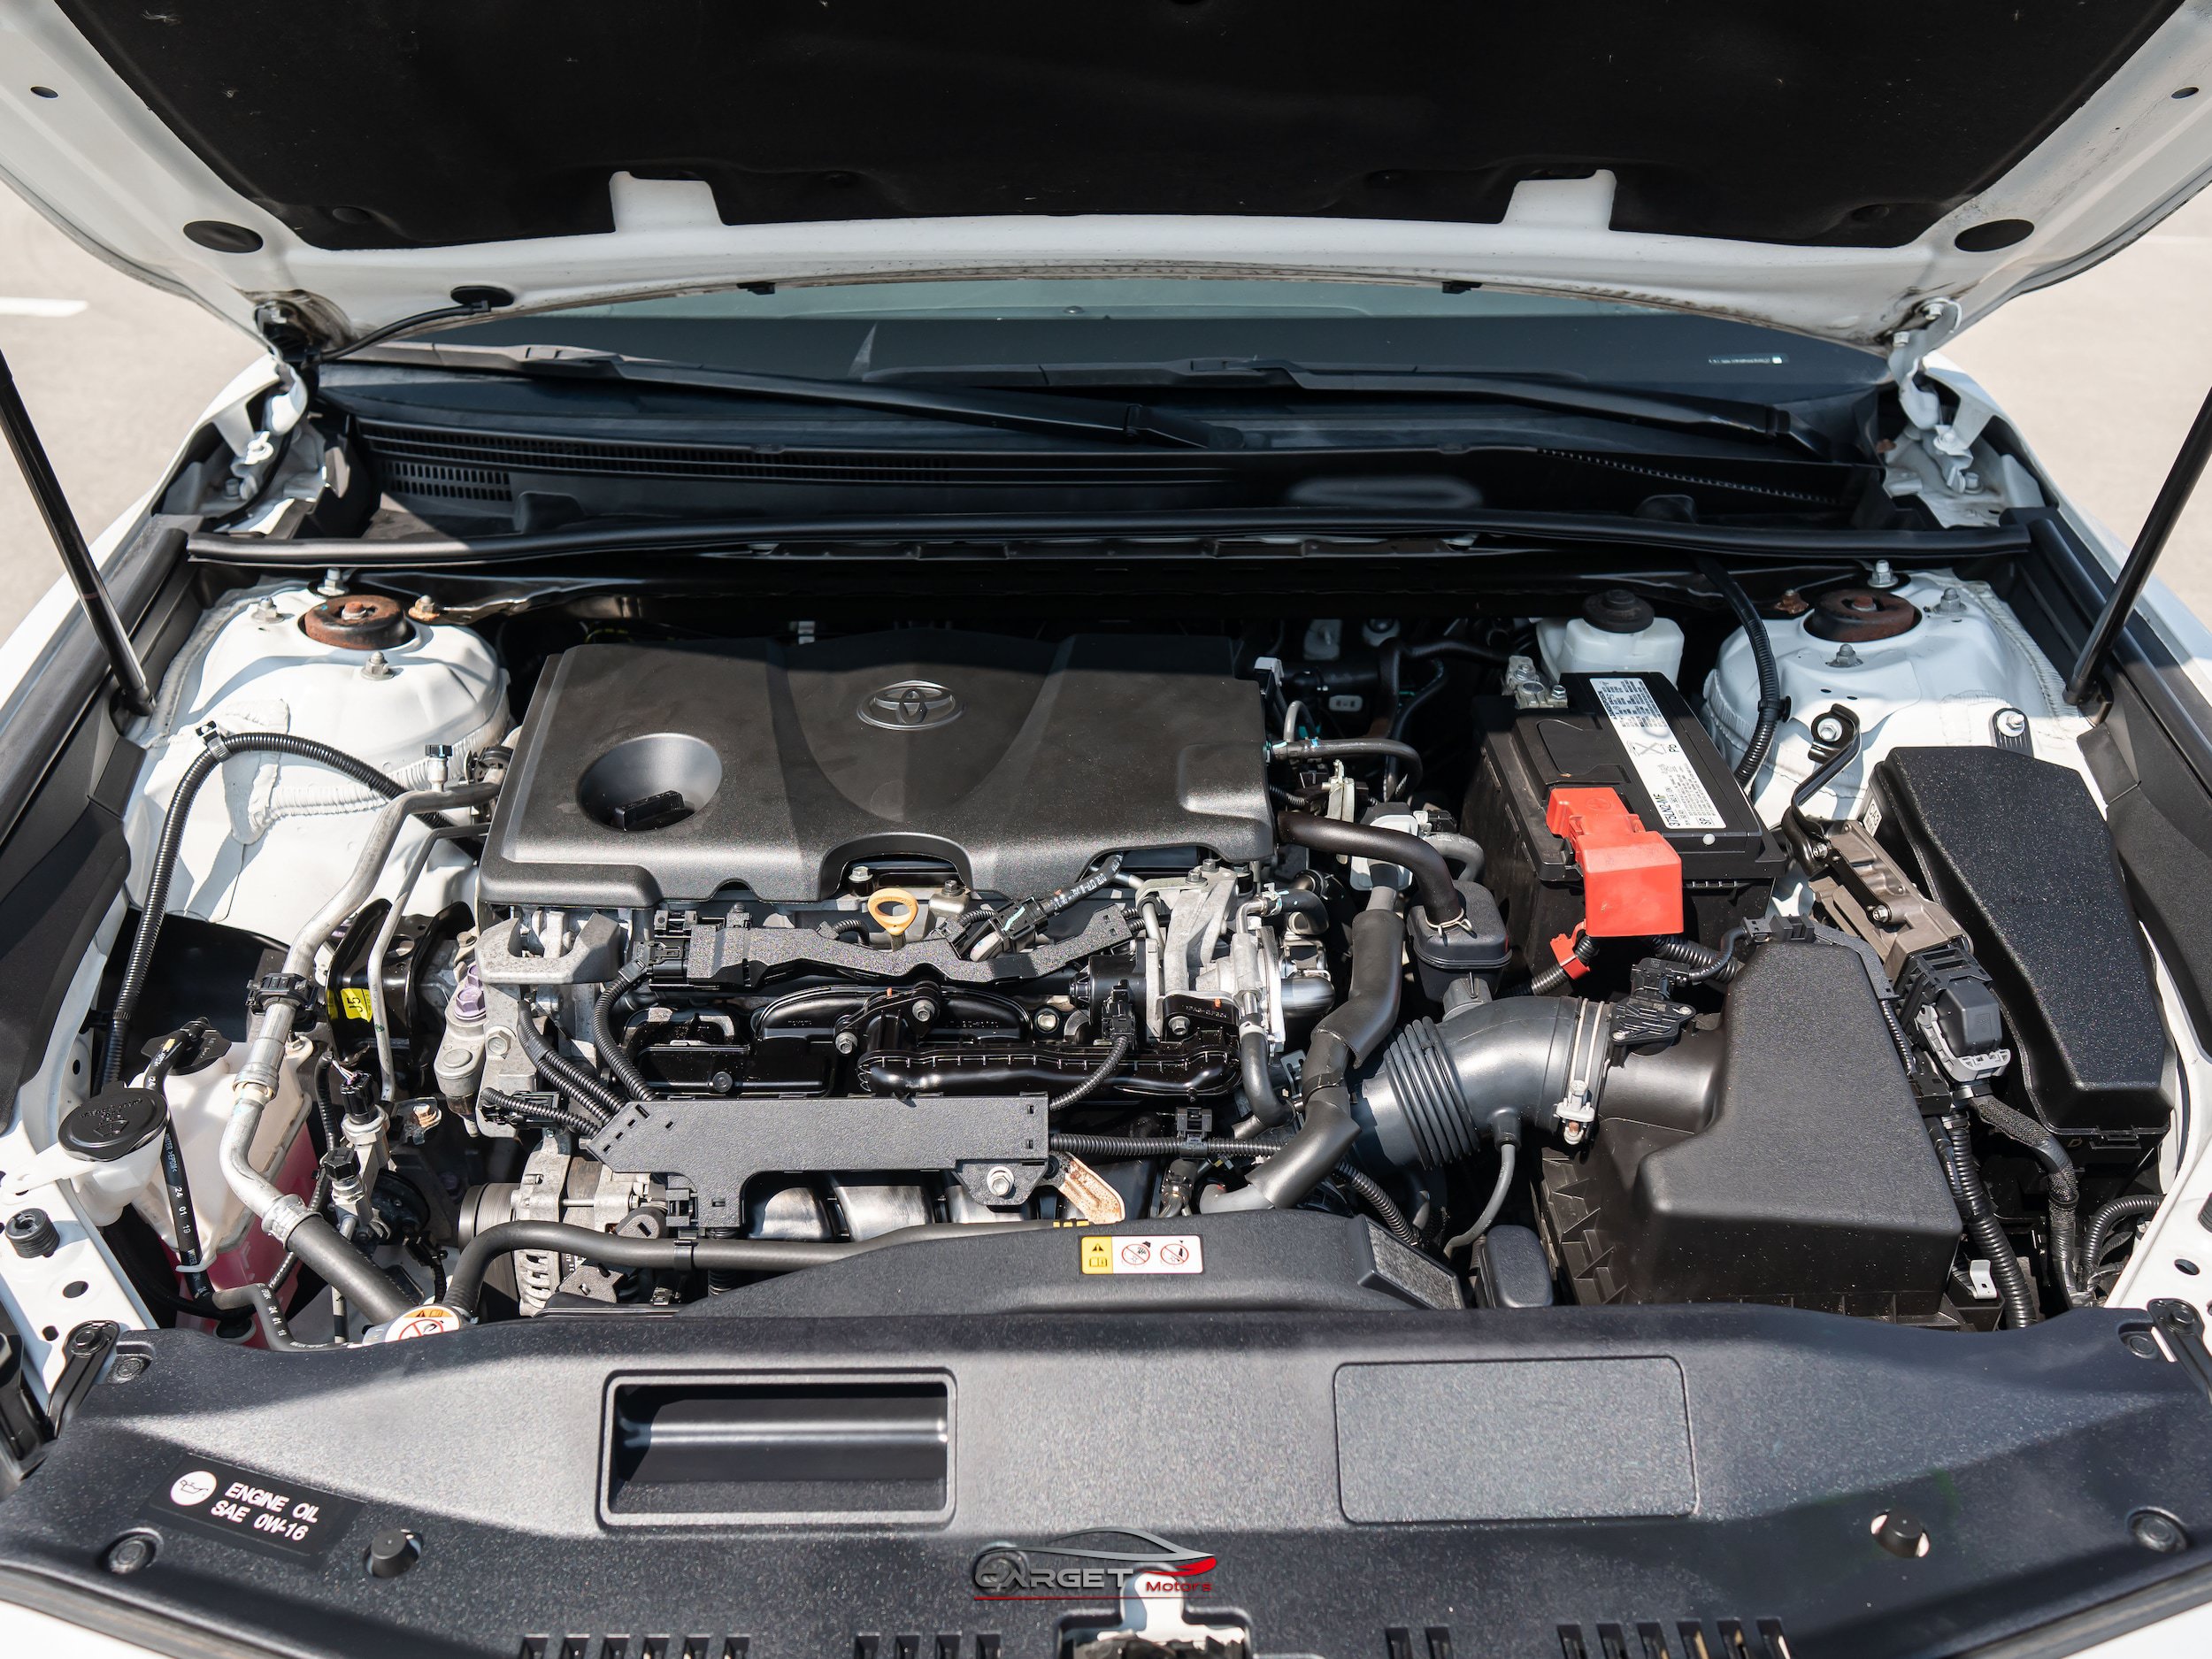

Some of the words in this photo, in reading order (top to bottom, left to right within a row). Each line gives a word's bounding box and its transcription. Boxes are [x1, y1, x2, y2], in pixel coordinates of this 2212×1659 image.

[1669, 744, 1679, 753] Pb
[347, 997, 364, 1012] J5
[174, 1187, 184, 1198] 24
[179, 1206, 188, 1217] 01
[182, 1225, 191, 1234] 19
[224, 1482, 290, 1512] ENGINE
[292, 1502, 319, 1523] OIL
[211, 1500, 251, 1523] SAE
[253, 1513, 309, 1540] 0W-16
